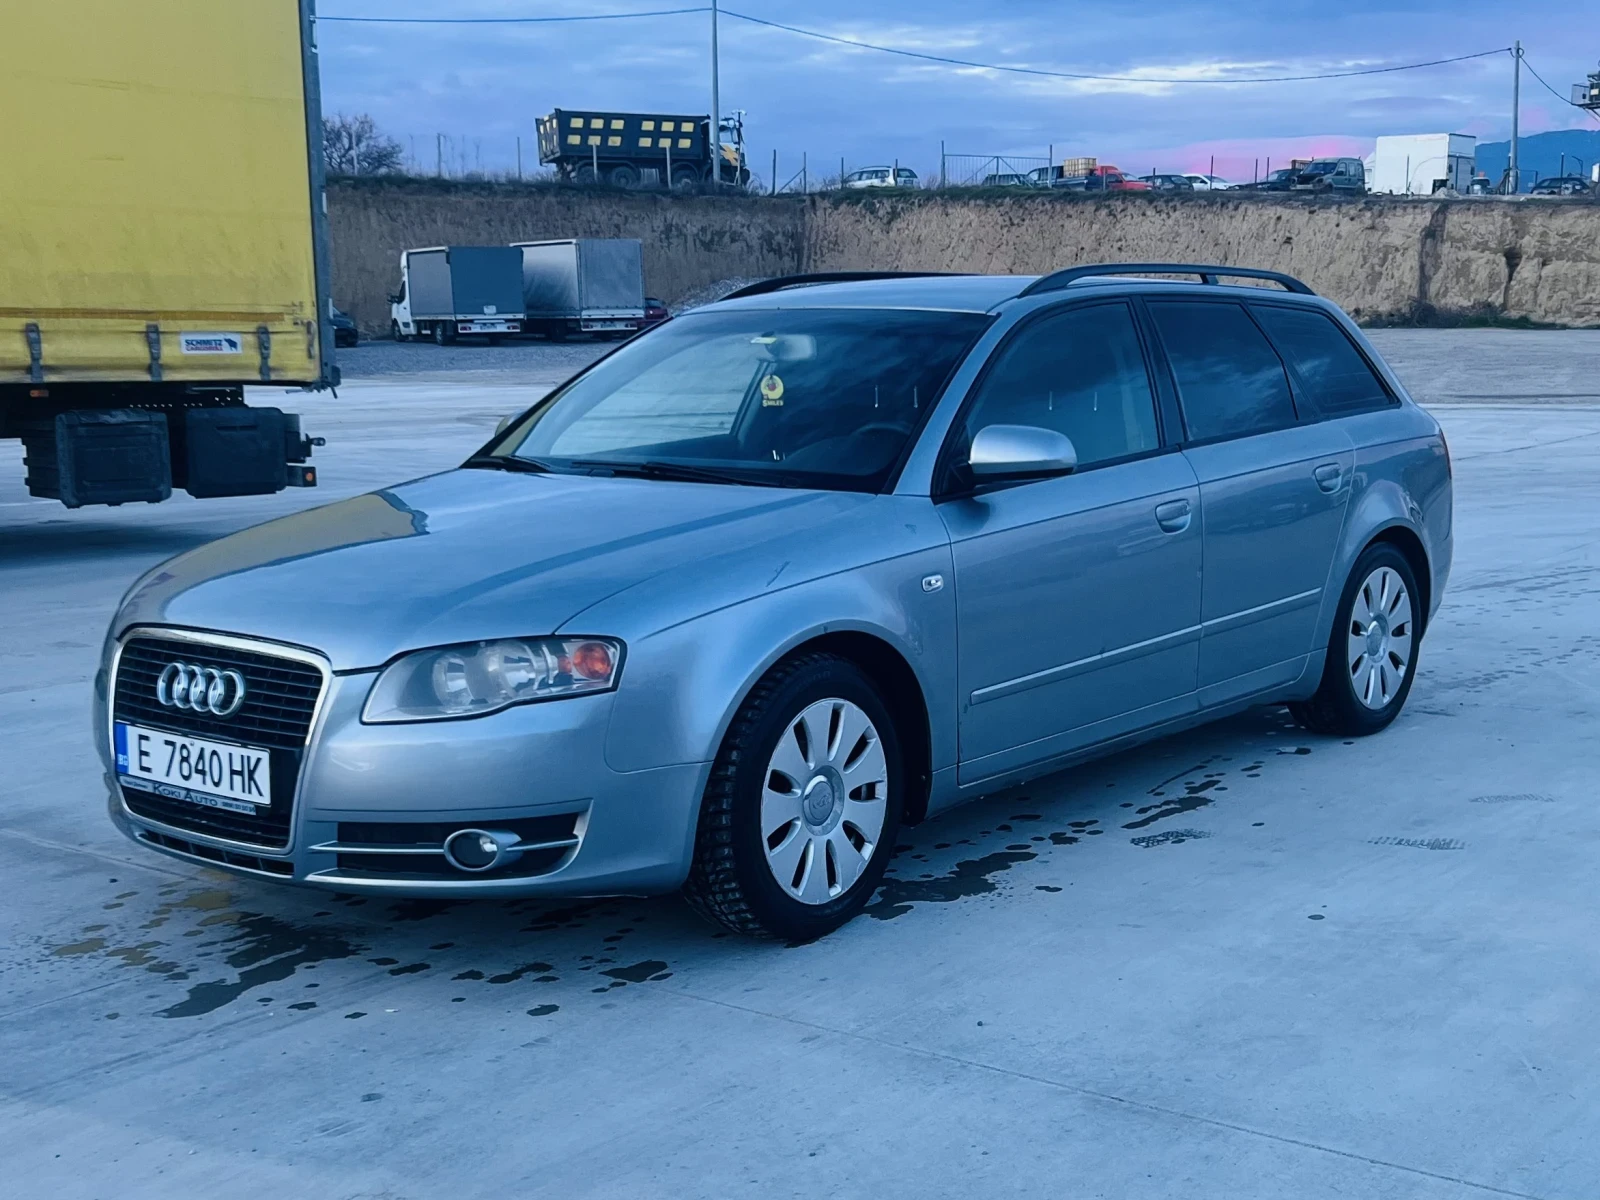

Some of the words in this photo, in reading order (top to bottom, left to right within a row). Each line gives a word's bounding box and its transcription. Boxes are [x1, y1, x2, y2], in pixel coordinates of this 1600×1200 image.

[184, 339, 223, 347] SCHMITZ
[137, 733, 153, 774] E
[164, 739, 223, 788] 7840
[229, 752, 265, 797] HK
